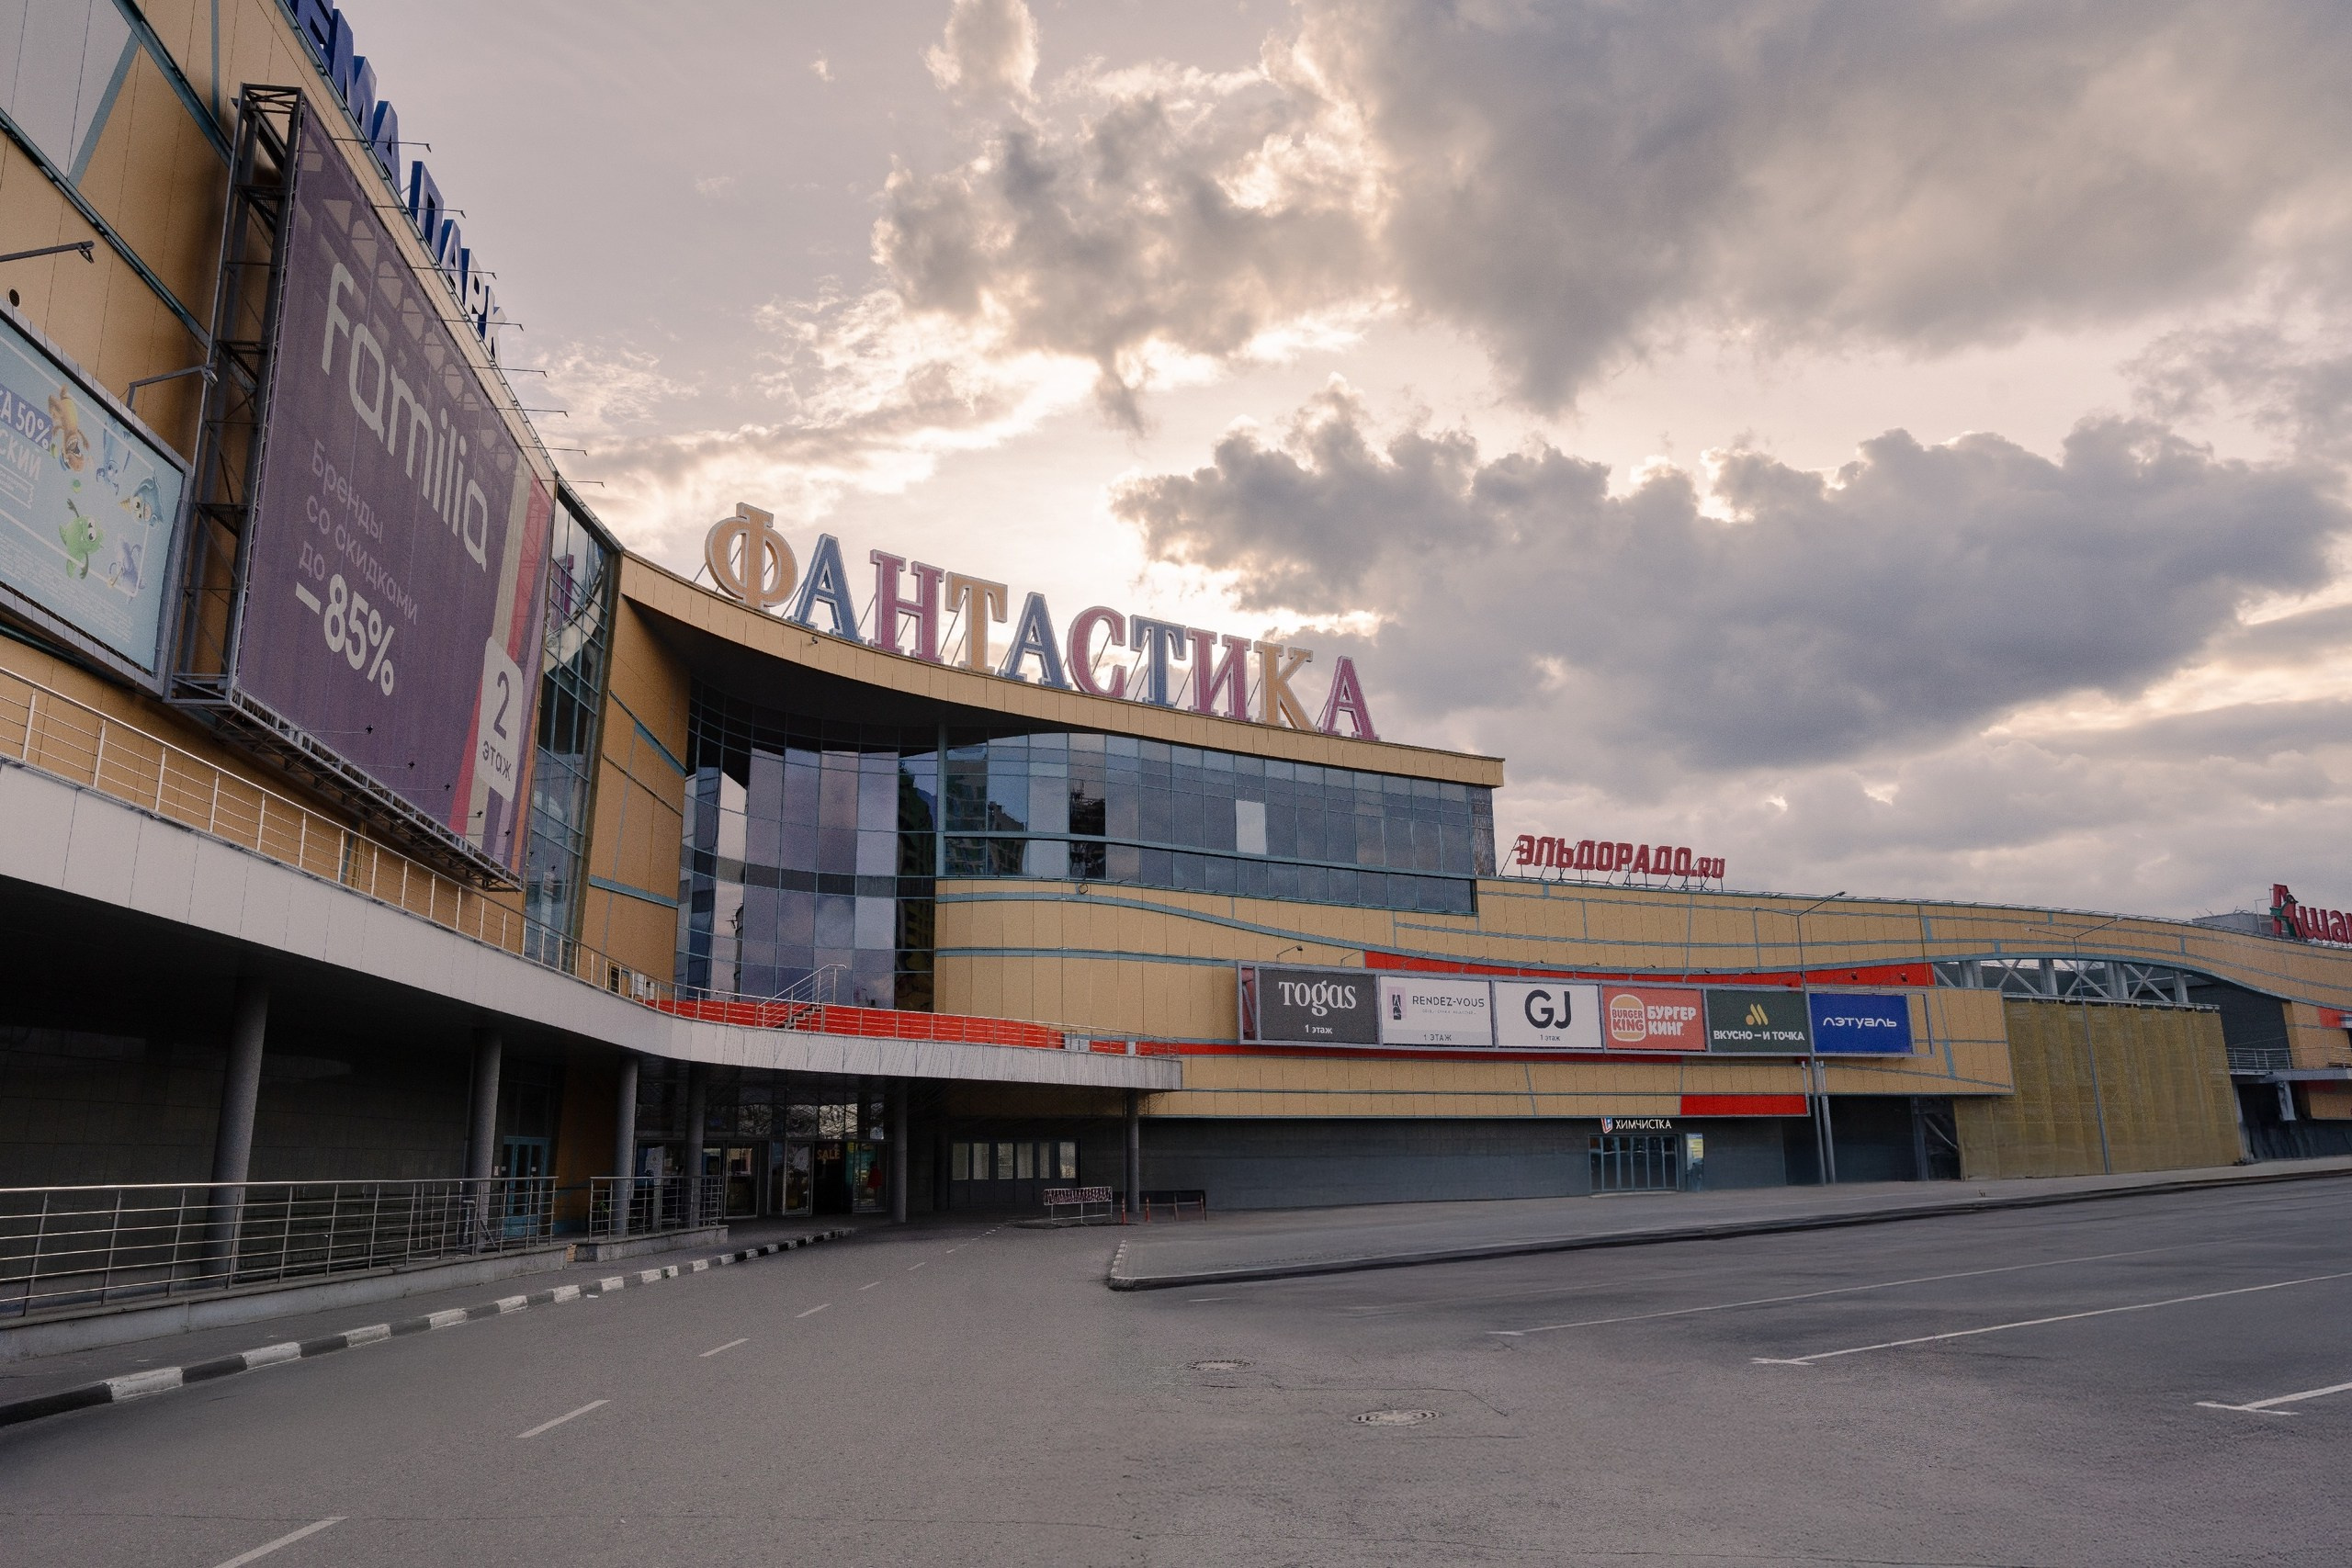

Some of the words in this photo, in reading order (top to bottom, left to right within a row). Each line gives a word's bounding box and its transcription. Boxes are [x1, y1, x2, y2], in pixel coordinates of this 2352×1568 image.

[409, 161, 507, 368] ПАРК
[16, 401, 51, 451] 50%
[322, 263, 488, 572] Familia
[311, 438, 383, 545] Бренды
[299, 541, 325, 581] до
[306, 495, 331, 535] со
[335, 525, 417, 626] скидками
[705, 502, 1379, 741] ФАНТАСТИКА
[493, 671, 510, 740] 2
[482, 740, 512, 781] этаж
[1412, 995, 1485, 1008] RENDEZ-VOUS
[1524, 989, 1572, 1030] GJ
[1611, 1009, 1644, 1019] BURGER
[1646, 1005, 1697, 1021] БУРГЕР
[1305, 1024, 1309, 1033] 1
[1312, 1025, 1332, 1034] этаж
[1611, 1018, 1645, 1032] KING
[1713, 1030, 1753, 1040] ВКУСНО
[1762, 1031, 1770, 1040] И
[1771, 1031, 1805, 1041] ТОЧКА
[1615, 1119, 1672, 1130] ХИМЧИСТКА
[817, 1149, 841, 1160] SALE
